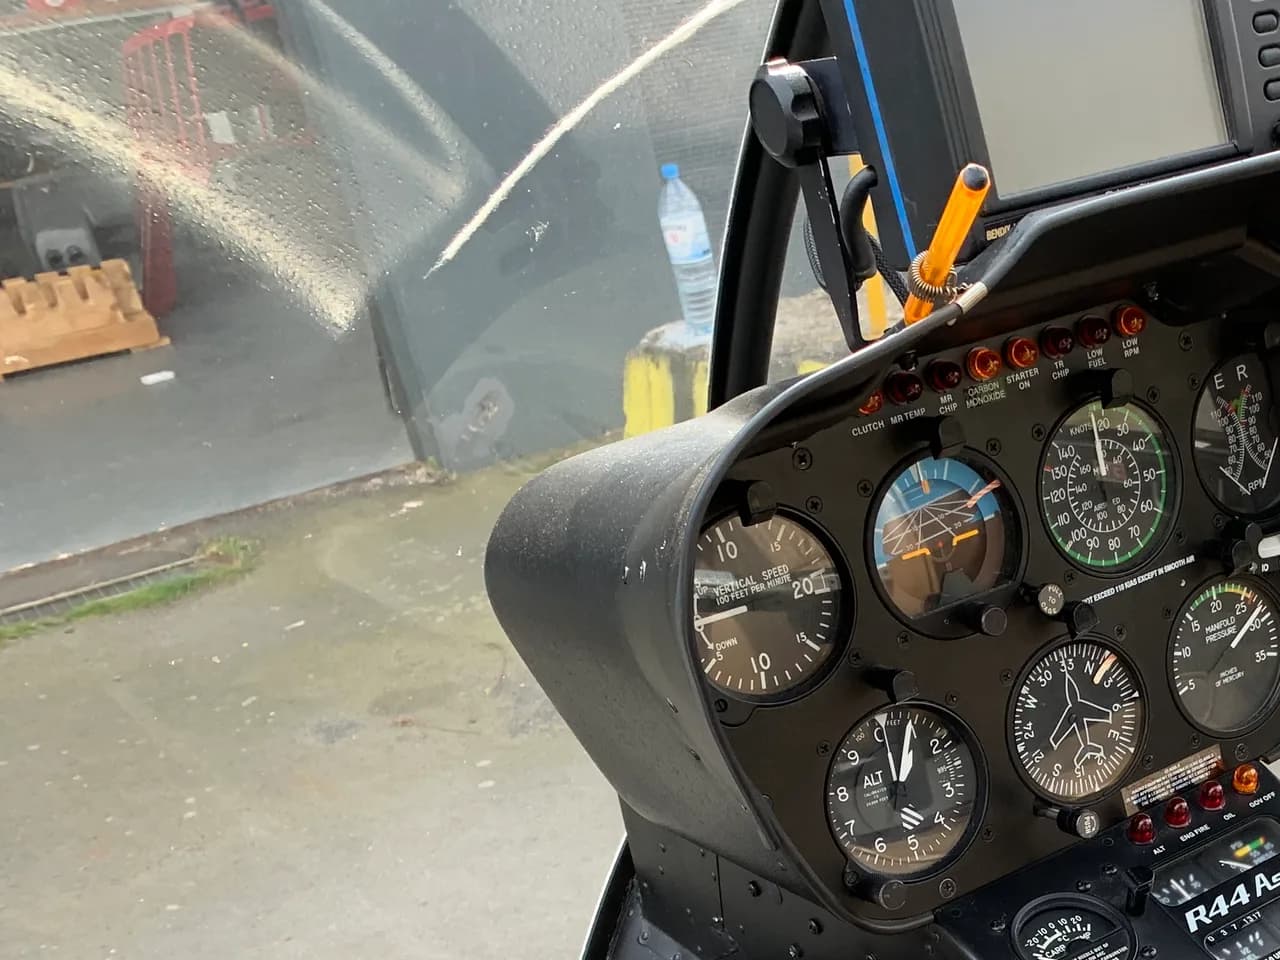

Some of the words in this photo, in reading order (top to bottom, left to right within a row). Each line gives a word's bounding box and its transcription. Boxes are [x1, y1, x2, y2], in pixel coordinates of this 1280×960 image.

[1122, 338, 1138, 349] LOW
[1086, 349, 1103, 360] LOW
[1124, 347, 1140, 358] RPM
[1054, 361, 1064, 370] TR
[1088, 358, 1107, 368] FUEL
[1006, 368, 1040, 384] STARTER
[1051, 369, 1070, 380] CHIP
[1236, 364, 1248, 381] R
[968, 382, 1000, 397] CARBON
[1018, 381, 1031, 391] ON
[1214, 374, 1224, 390] E
[940, 394, 954, 405] MR
[966, 390, 1006, 408] MONOXIDE
[890, 415, 904, 425] MR
[903, 408, 926, 421] TEMP
[939, 403, 958, 415] CHIP
[851, 420, 885, 437] CLUTCH
[1097, 417, 1110, 432] 20
[1116, 422, 1129, 437] 30
[1132, 438, 1146, 452] 40
[1058, 445, 1075, 461] 140
[1051, 465, 1067, 480] 130
[1143, 468, 1156, 482] 50
[1049, 489, 1066, 504] 120
[1140, 501, 1153, 513] 60
[1057, 513, 1070, 527] 110
[1071, 527, 1087, 542] 100
[1128, 524, 1140, 539] 70
[717, 541, 738, 562] 10
[770, 542, 781, 552] 15
[1086, 538, 1100, 550] 90
[1108, 537, 1121, 551] 80
[713, 576, 757, 597] VERTICAL
[762, 564, 789, 579] SPEED
[715, 596, 730, 605] 100
[731, 590, 749, 601] FEET
[751, 584, 766, 594] PER
[766, 574, 792, 589] MINUTE
[792, 578, 813, 599] 20
[1210, 600, 1223, 613] 20
[1235, 602, 1247, 615] 25
[1191, 620, 1200, 632] 15
[1205, 616, 1236, 633] MANIFOLD
[796, 632, 807, 643] 15
[1205, 626, 1238, 644] PRESSURE
[715, 637, 738, 651] DOWN
[1182, 647, 1191, 658] 10
[1255, 650, 1267, 663] 35
[750, 652, 771, 674] 10
[1060, 658, 1075, 673] 33
[1084, 661, 1095, 675] N
[1036, 670, 1053, 687] 30
[1103, 677, 1114, 688] 3
[1025, 694, 1039, 709] W
[1024, 721, 1035, 740] 24
[1108, 729, 1120, 741] E
[929, 739, 943, 755] 2
[847, 750, 859, 766] 9
[1052, 763, 1062, 777] S
[863, 770, 883, 789] ALT
[836, 786, 849, 802] 8
[942, 781, 954, 798] 3
[1249, 797, 1264, 809] GOV
[1262, 791, 1276, 803] OFF
[934, 811, 946, 825] 4
[1223, 812, 1236, 821] OIL
[844, 819, 855, 836] 7
[1179, 832, 1194, 843] ENG
[1193, 824, 1211, 836] FIRE
[874, 837, 887, 853] 6
[907, 834, 919, 851] 5
[1152, 845, 1166, 856] ALT
[1185, 883, 1250, 933] R44
